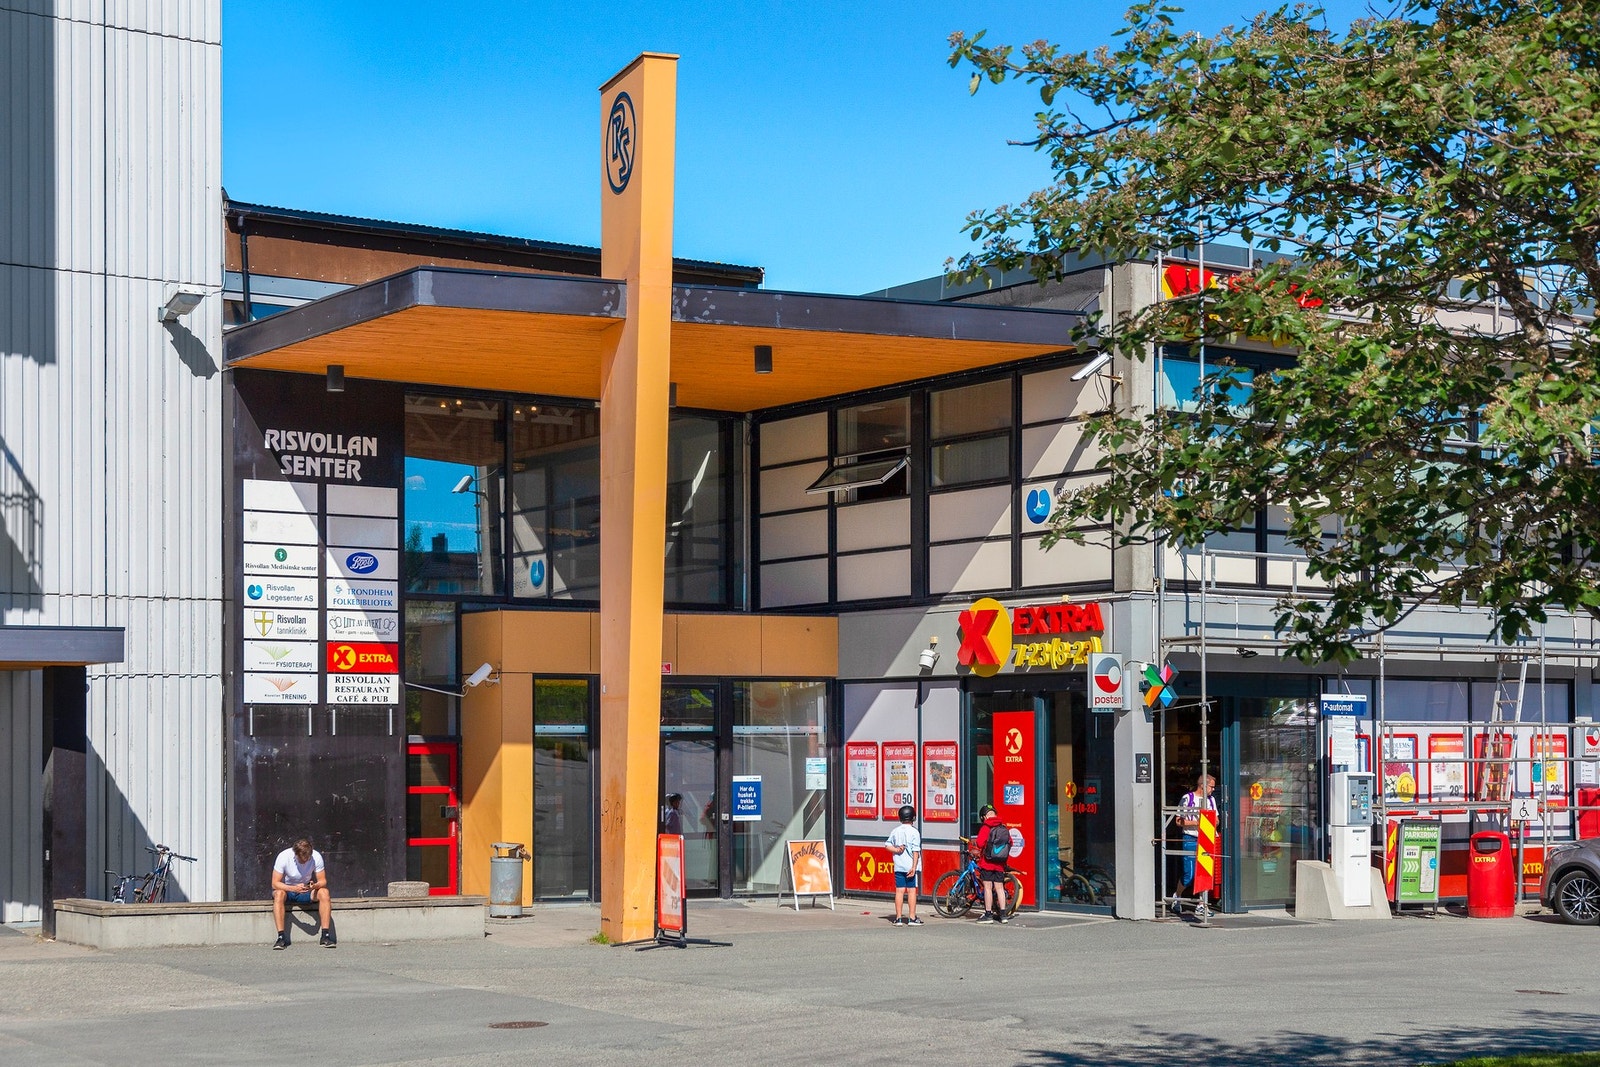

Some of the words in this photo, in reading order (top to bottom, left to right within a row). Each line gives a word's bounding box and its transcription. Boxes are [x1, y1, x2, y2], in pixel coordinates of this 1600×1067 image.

[264, 429, 377, 457] RISVOLLAN
[280, 455, 362, 482] SENTER
[350, 556, 374, 570] Boots
[347, 588, 393, 596] TRONDHEIM
[266, 594, 303, 602] Legesenter
[333, 598, 393, 607] FOLKEBIBLIOTEK
[277, 614, 306, 624] Risvollan
[343, 616, 355, 628] LITT
[356, 618, 363, 627] AV
[364, 617, 382, 629] HVERT
[1013, 602, 1105, 635] EXTRA
[277, 627, 307, 635] tannklinikk
[359, 653, 393, 663] EXTRA
[335, 676, 390, 684] RISVOLLAN
[336, 694, 359, 702] CAFÉ
[1094, 695, 1122, 705] posten
[1323, 702, 1353, 711] P-automat
[1449, 785, 1459, 797] 29
[1551, 784, 1560, 795] 29
[865, 792, 873, 803] 27
[902, 793, 912, 804] 50
[944, 794, 954, 805] 40
[1404, 831, 1438, 839] PARKERING
[877, 862, 894, 873] EXT
[1523, 862, 1544, 874] XTR
